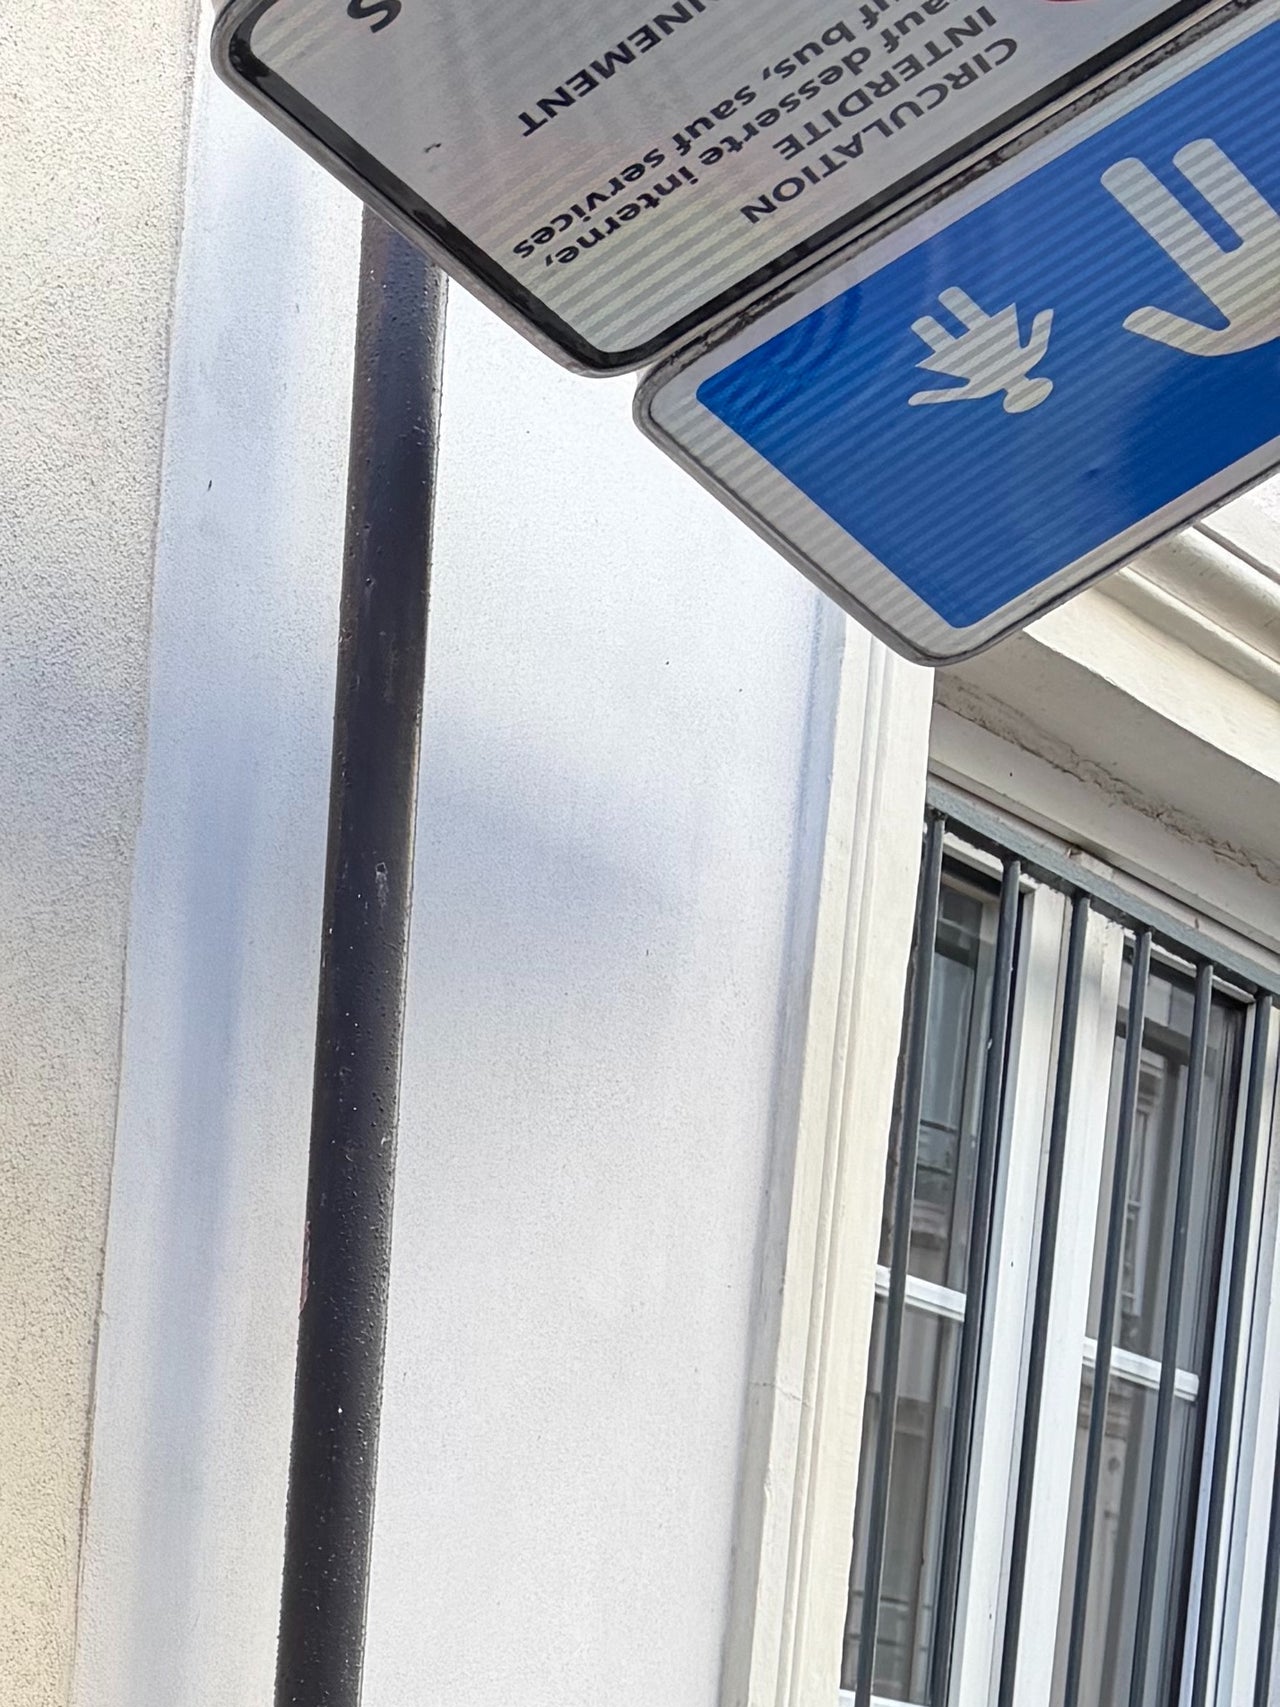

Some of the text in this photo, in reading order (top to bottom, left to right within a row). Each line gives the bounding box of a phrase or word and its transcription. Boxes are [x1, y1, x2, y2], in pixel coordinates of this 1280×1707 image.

[699, 45, 872, 166] desserte
[761, 21, 856, 81] bus,
[772, 5, 998, 160] INTERDITE
[671, 84, 758, 158] sauf
[740, 37, 1018, 224] CIRCULATION
[513, 147, 666, 261] services
[543, 166, 700, 267] interne,
